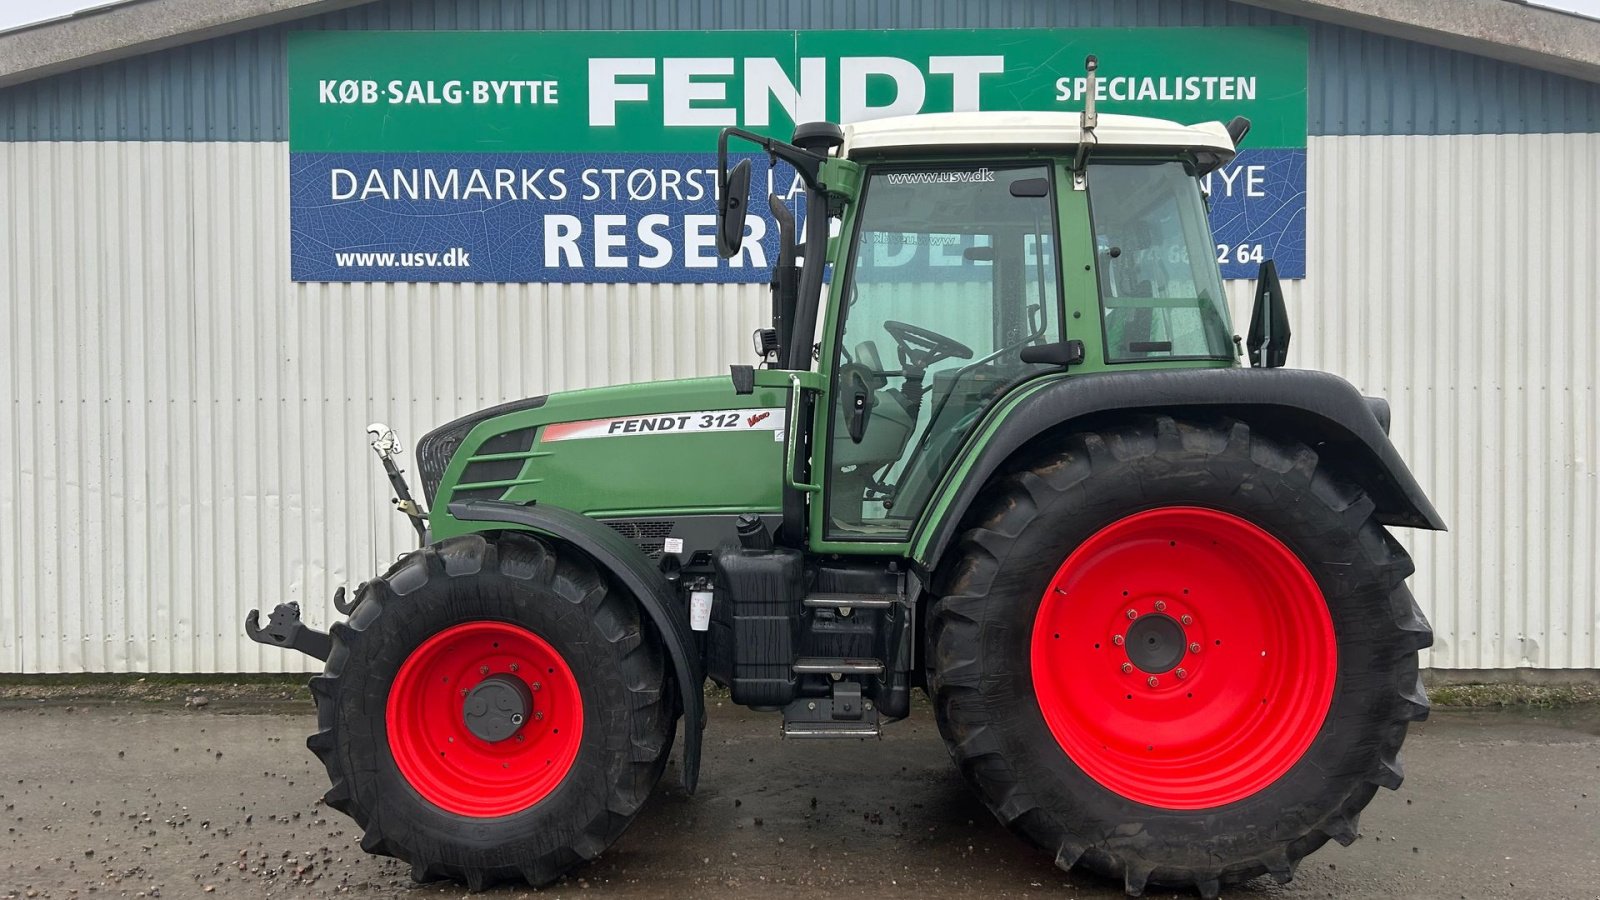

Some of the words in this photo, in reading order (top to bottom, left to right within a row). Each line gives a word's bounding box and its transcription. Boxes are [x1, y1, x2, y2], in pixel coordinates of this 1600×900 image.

[588, 55, 1004, 127] FENDT
[1055, 76, 1256, 101] SPECIALISTEN
[331, 168, 567, 201] DANMARKS
[581, 168, 750, 201] STØRST
[887, 168, 995, 184] www.usv.dk
[335, 247, 470, 267] www.usv.dk
[1236, 243, 1264, 264] 64
[608, 416, 691, 434] FENDT
[698, 413, 740, 429] 312
